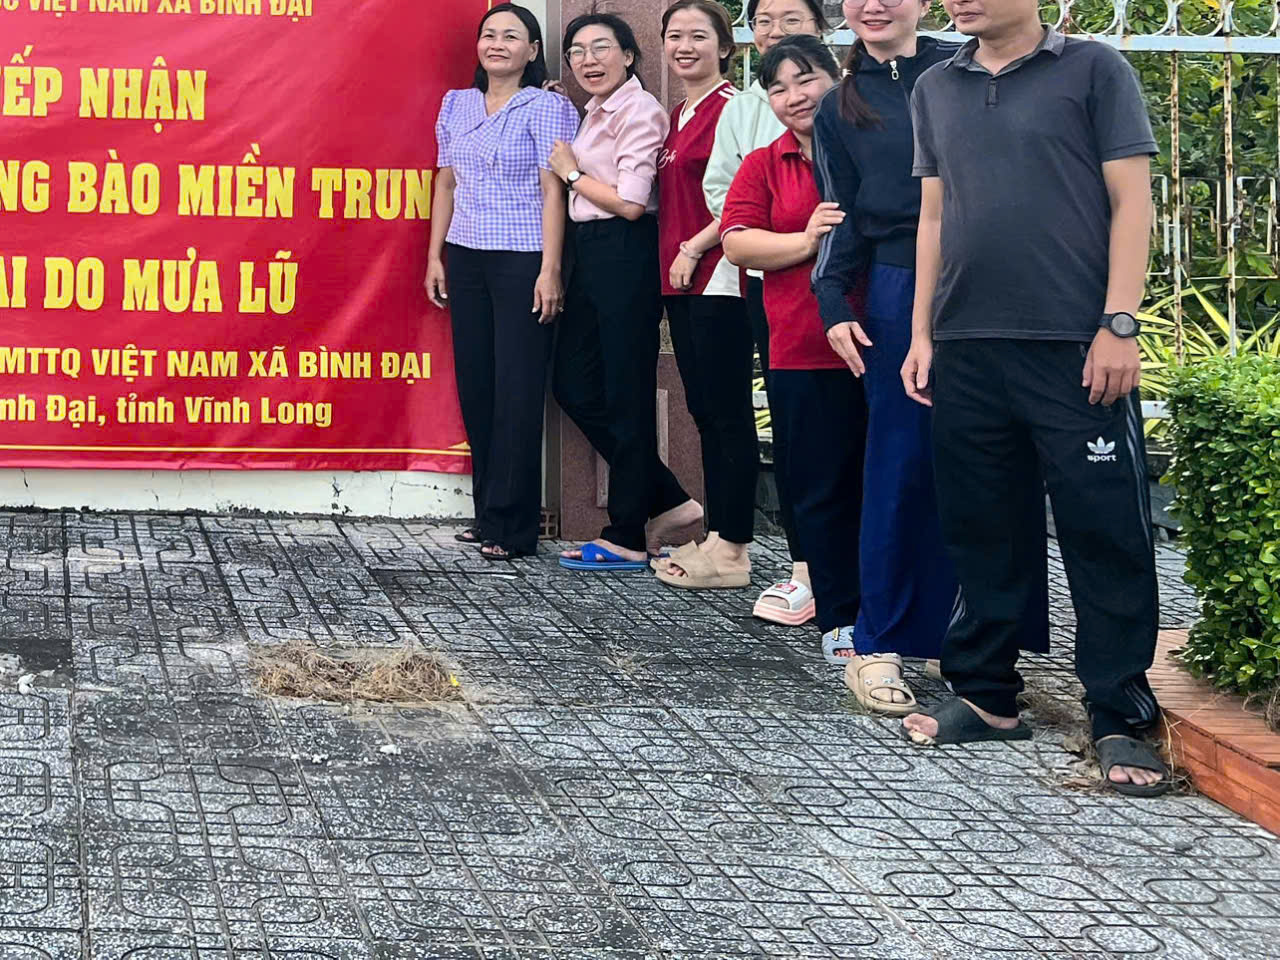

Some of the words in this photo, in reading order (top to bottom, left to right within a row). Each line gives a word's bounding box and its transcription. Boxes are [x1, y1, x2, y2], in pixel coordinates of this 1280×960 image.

[79, 55, 207, 134] NHẬN
[67, 149, 160, 216] BÀO
[177, 143, 296, 218] MIỀN
[311, 167, 432, 220] TRUN
[43, 256, 105, 311] DO
[122, 247, 223, 313] MƯA
[238, 250, 298, 314] LŨ
[91, 343, 157, 383] VIỆT
[167, 350, 238, 377] NAM
[247, 345, 289, 378] XÃ
[298, 345, 371, 378] BÌNH
[380, 352, 431, 384] ĐẠI
[45, 394, 106, 428] Đại,
[116, 392, 174, 423] tỉnh
[184, 396, 250, 424] Vĩnh
[261, 397, 332, 428] Long
